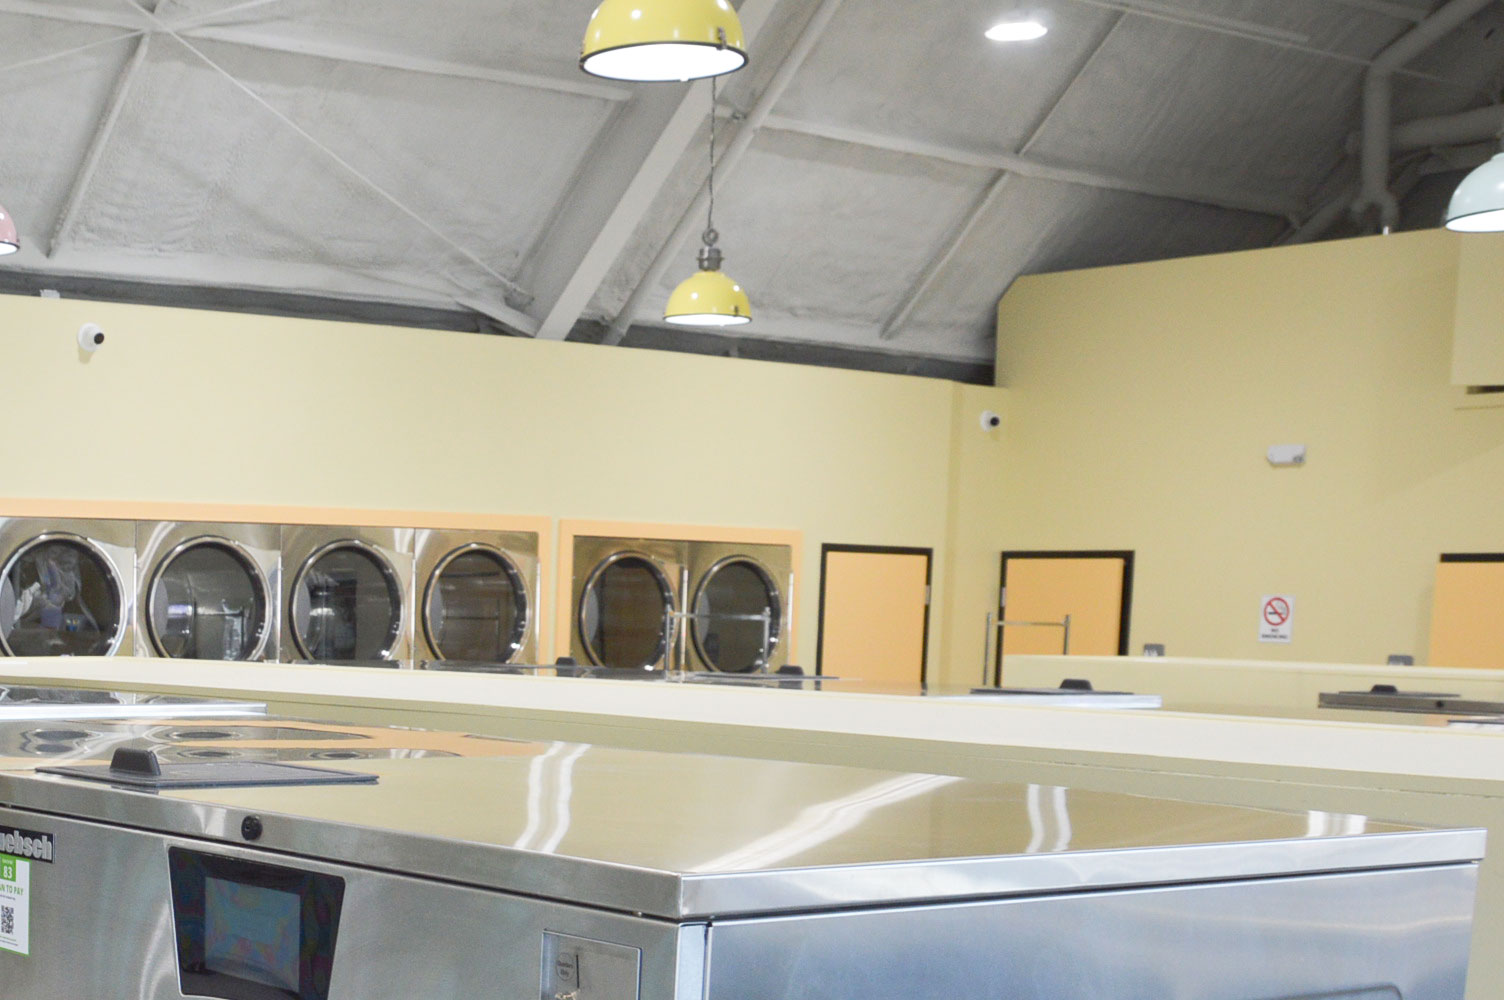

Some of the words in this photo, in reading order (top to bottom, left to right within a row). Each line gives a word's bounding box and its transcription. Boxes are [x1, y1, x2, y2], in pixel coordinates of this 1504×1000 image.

[3, 865, 13, 879] 83
[6, 884, 13, 894] TO
[13, 886, 25, 896] PAY
